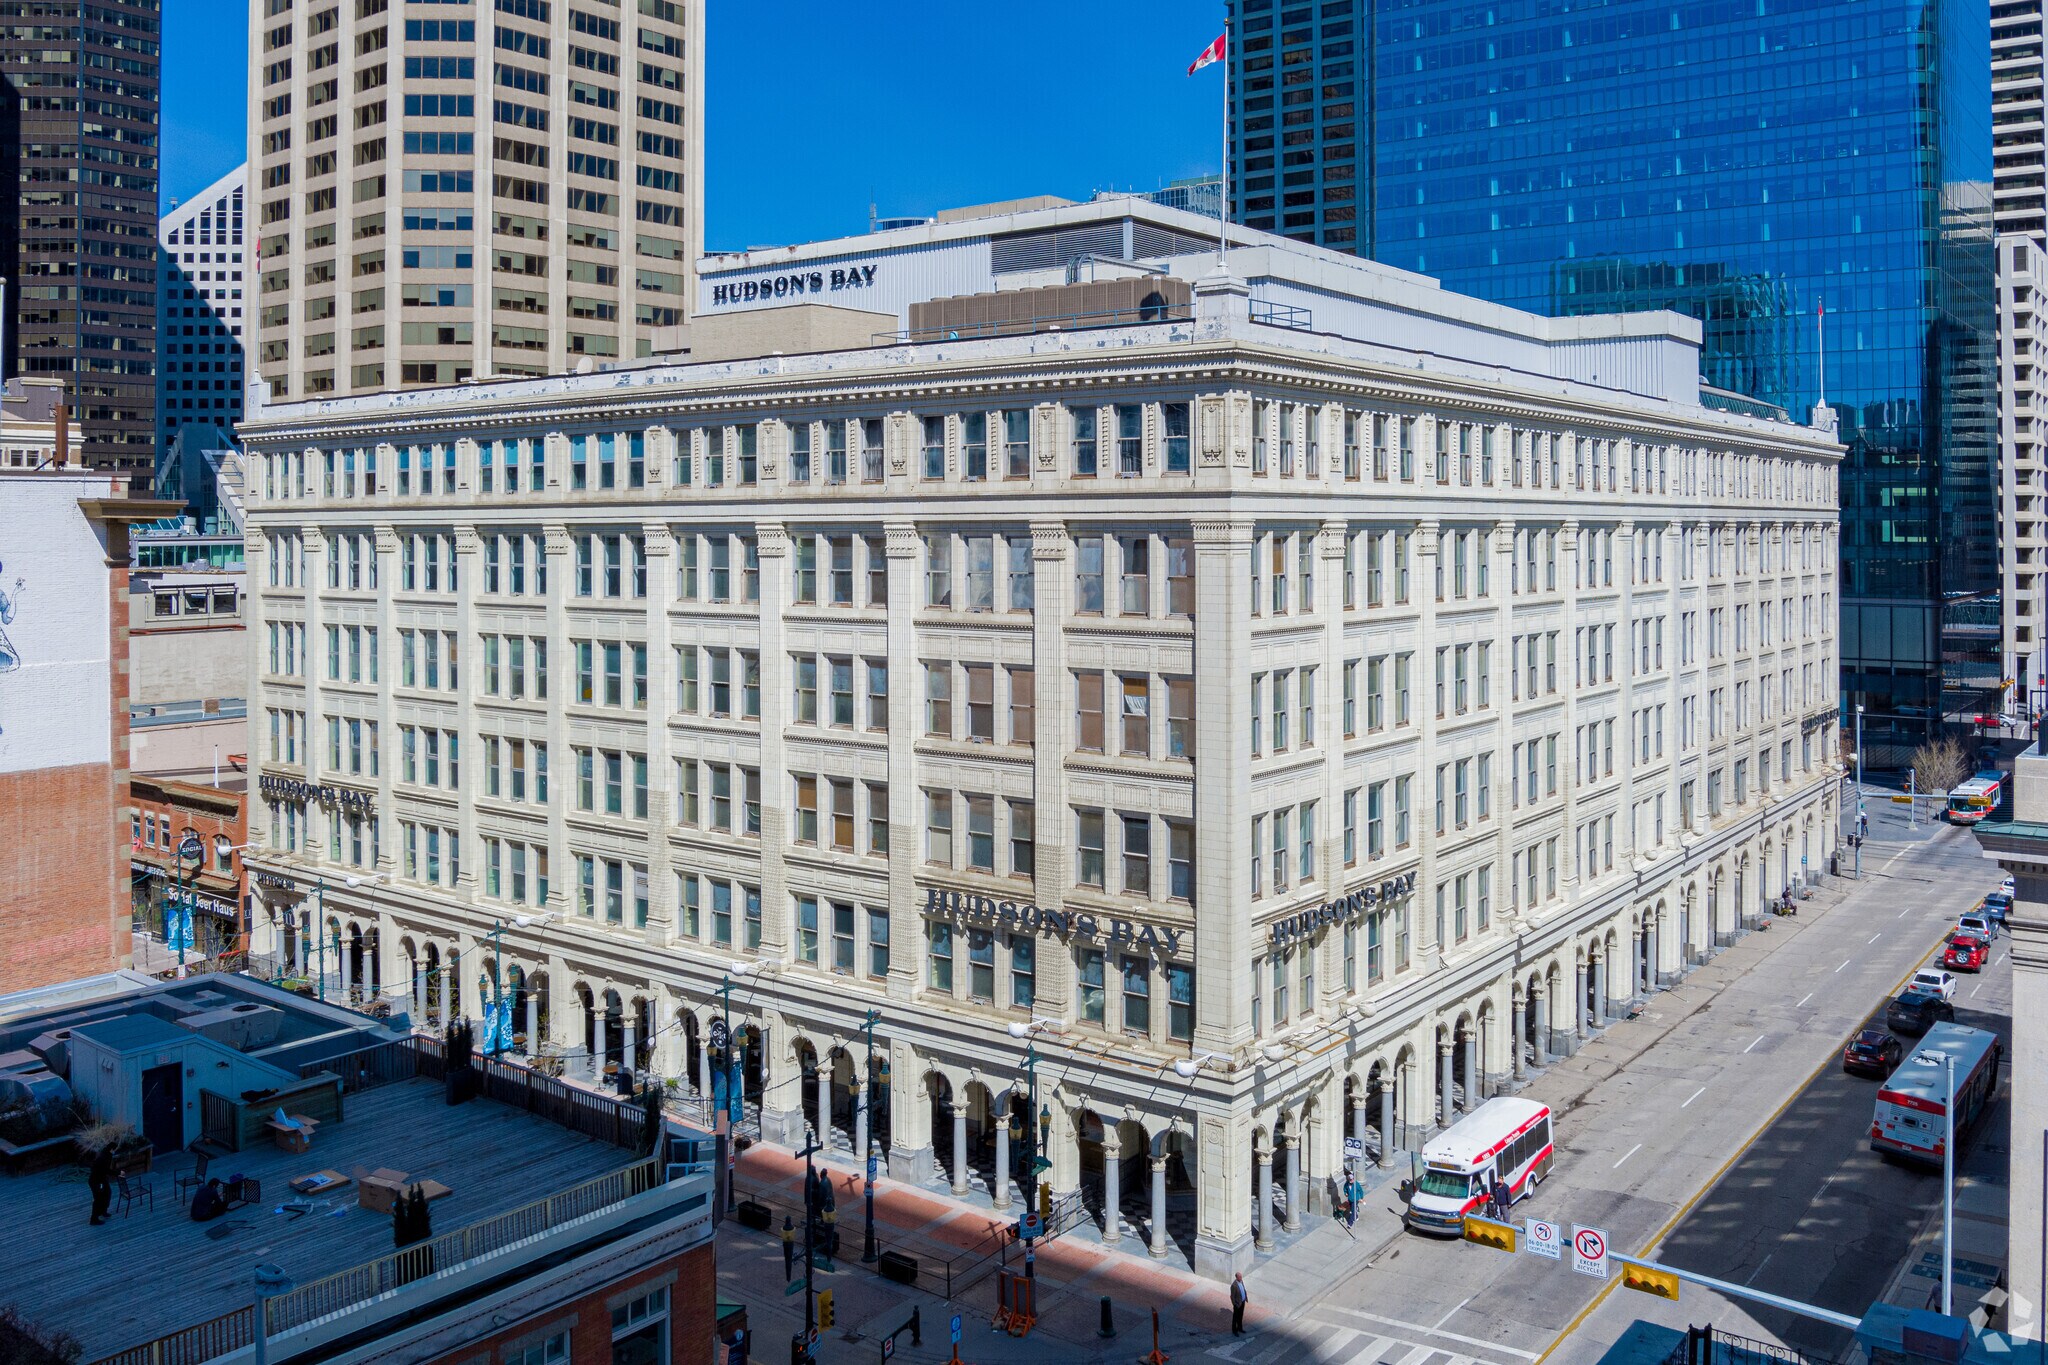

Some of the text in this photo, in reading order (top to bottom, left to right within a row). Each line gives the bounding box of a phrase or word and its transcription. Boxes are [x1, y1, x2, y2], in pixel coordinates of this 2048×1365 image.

[713, 264, 878, 301] HUDSON'S BAY
[258, 775, 373, 805] HUDSON'S BAY
[181, 845, 203, 853] SOCIAL
[168, 887, 192, 905] Soial
[213, 899, 235, 917] Haus
[1272, 870, 1418, 945] HUDSON'S BAY
[925, 888, 1185, 953] HUDSON'S BAY
[1577, 1264, 1603, 1276] BICYCLES
[1580, 1259, 1600, 1269] EXCEPT
